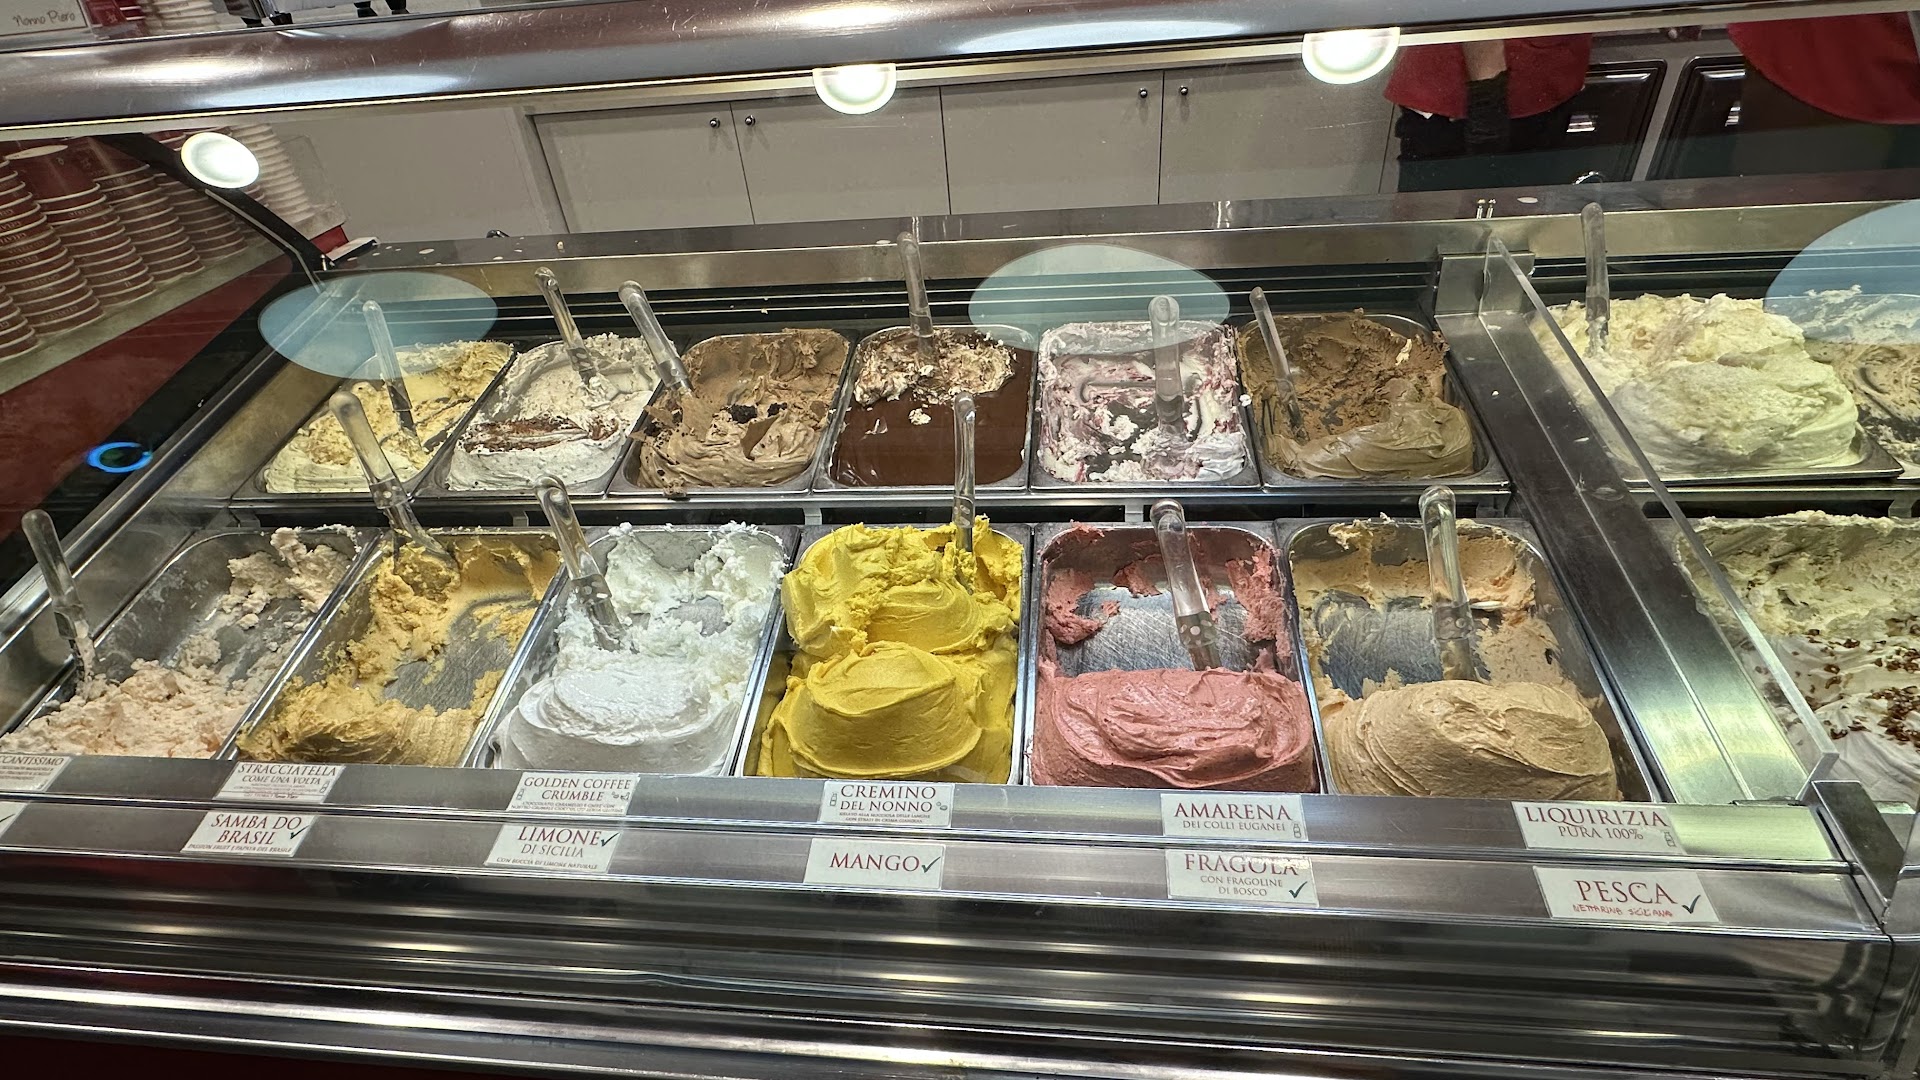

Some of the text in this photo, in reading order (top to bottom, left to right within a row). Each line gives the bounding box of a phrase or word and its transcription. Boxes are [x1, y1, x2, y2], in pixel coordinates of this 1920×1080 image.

[238, 763, 336, 777] STRACCIATELLA
[242, 775, 321, 785] COME UNA VOLTA
[524, 777, 632, 790] GOLDEN COFFEE
[541, 790, 604, 801] CRUMBLE
[840, 784, 936, 800] CREMINO
[840, 800, 933, 813] DEL NONNO
[1174, 802, 1293, 821] AMARENA
[211, 813, 303, 830] SAMBA DO
[1524, 806, 1670, 827] LIQUIRIZIA
[1183, 820, 1286, 832] DEI COLLI EUGANEI
[1558, 825, 1644, 840] PURA 100%
[217, 830, 277, 845] BRASIL
[517, 826, 602, 846] LIMONE
[520, 843, 584, 858] DI SICILIA
[829, 852, 920, 872] MANGO
[1184, 853, 1299, 876] FRAGOLA
[1200, 875, 1283, 888] CON FRAGOLINE
[1218, 886, 1268, 897] DI BOSCO
[1574, 879, 1679, 905] PESCA
